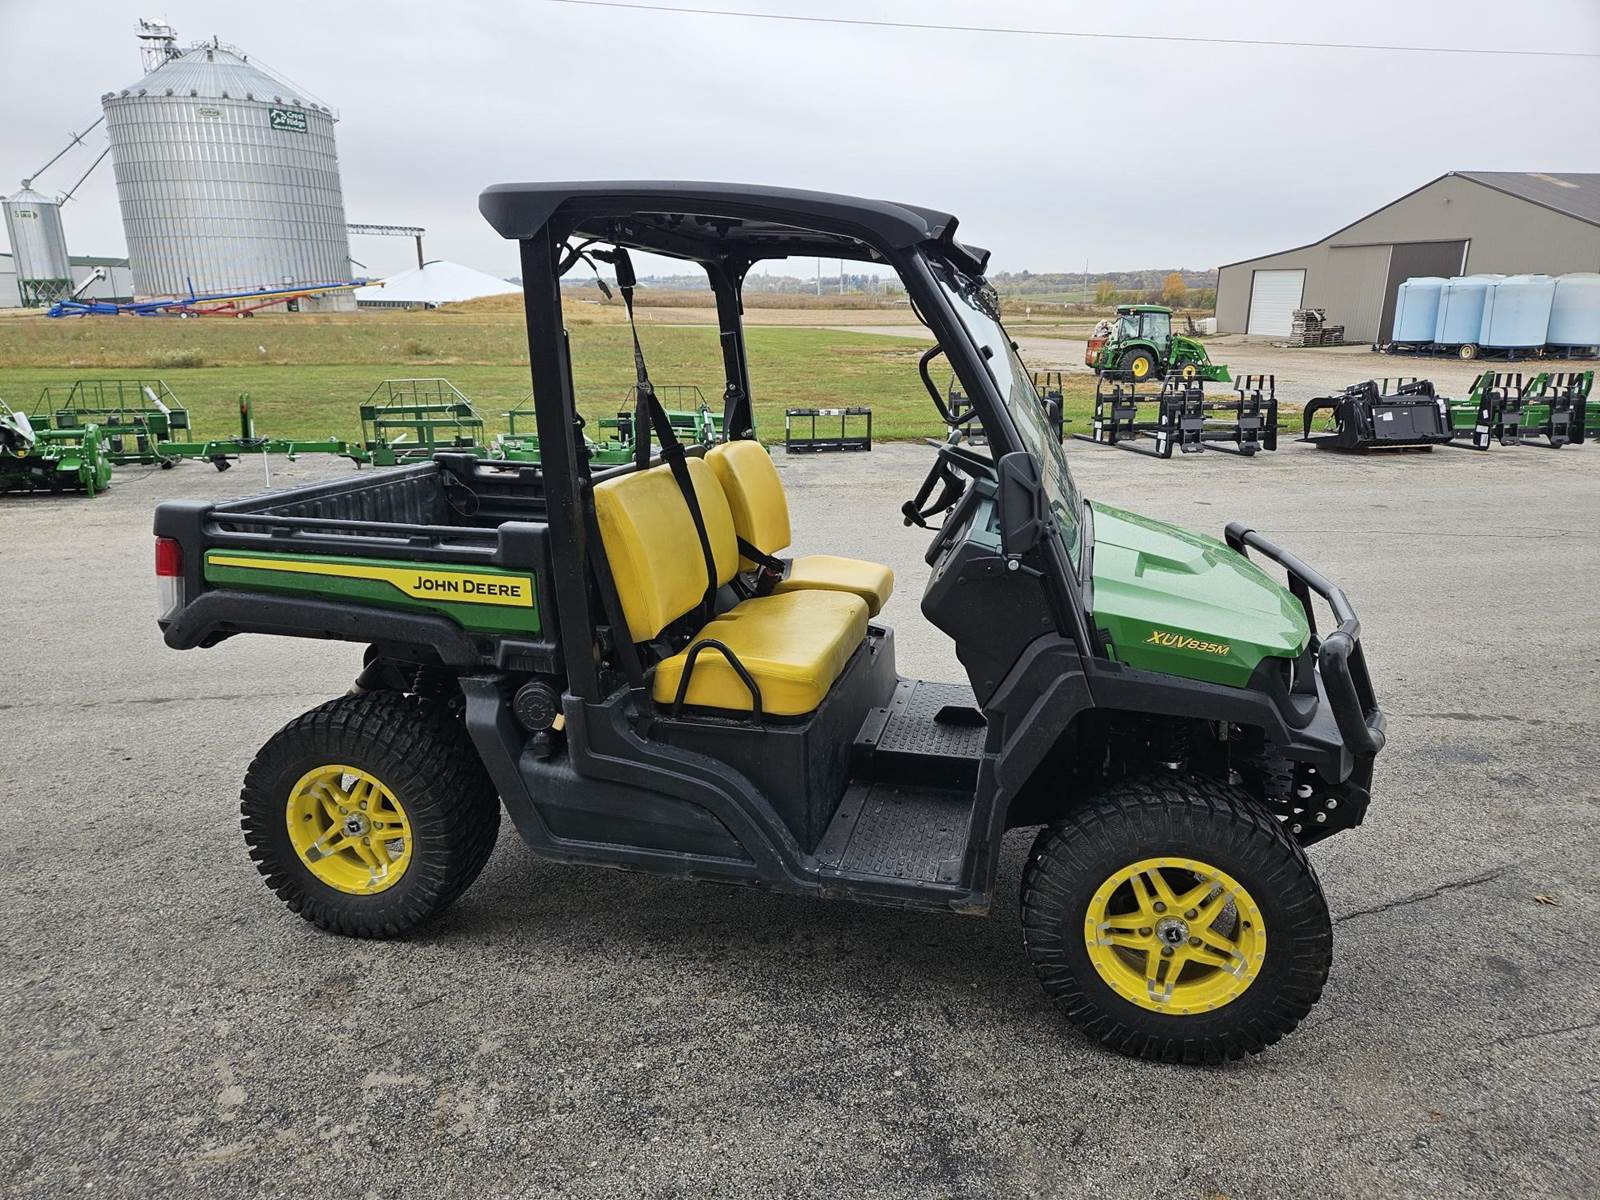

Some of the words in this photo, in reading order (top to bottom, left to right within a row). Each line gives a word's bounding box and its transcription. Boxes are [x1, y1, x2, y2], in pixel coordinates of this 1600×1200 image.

[413, 576, 459, 592] JOHN
[463, 579, 521, 597] DEERE
[1143, 630, 1231, 656] XUV835M
